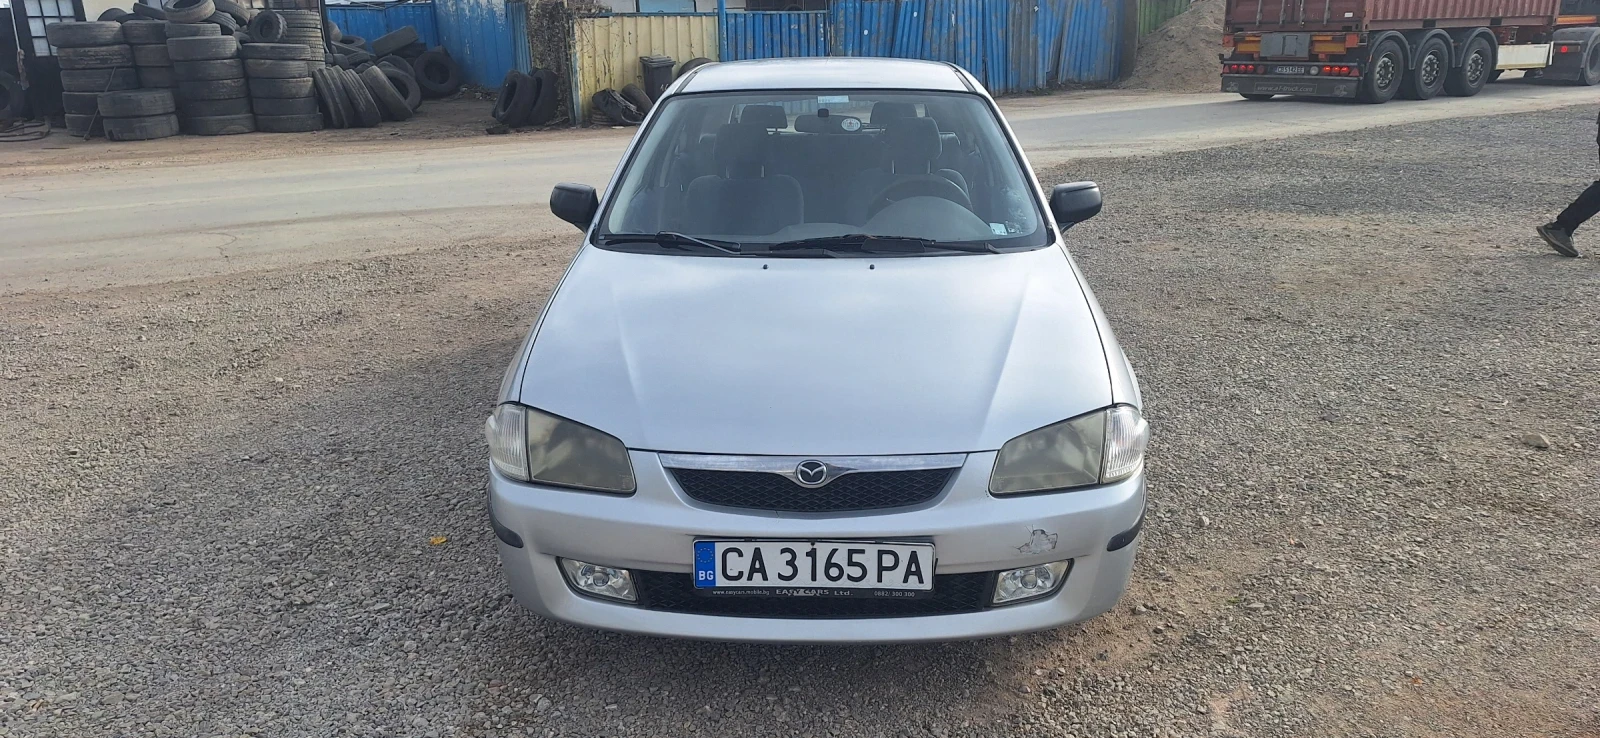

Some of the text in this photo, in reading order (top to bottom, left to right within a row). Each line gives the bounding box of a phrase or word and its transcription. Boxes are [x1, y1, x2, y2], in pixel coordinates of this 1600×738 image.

[698, 571, 713, 580] BG
[722, 548, 924, 584] CA 3165 PA
